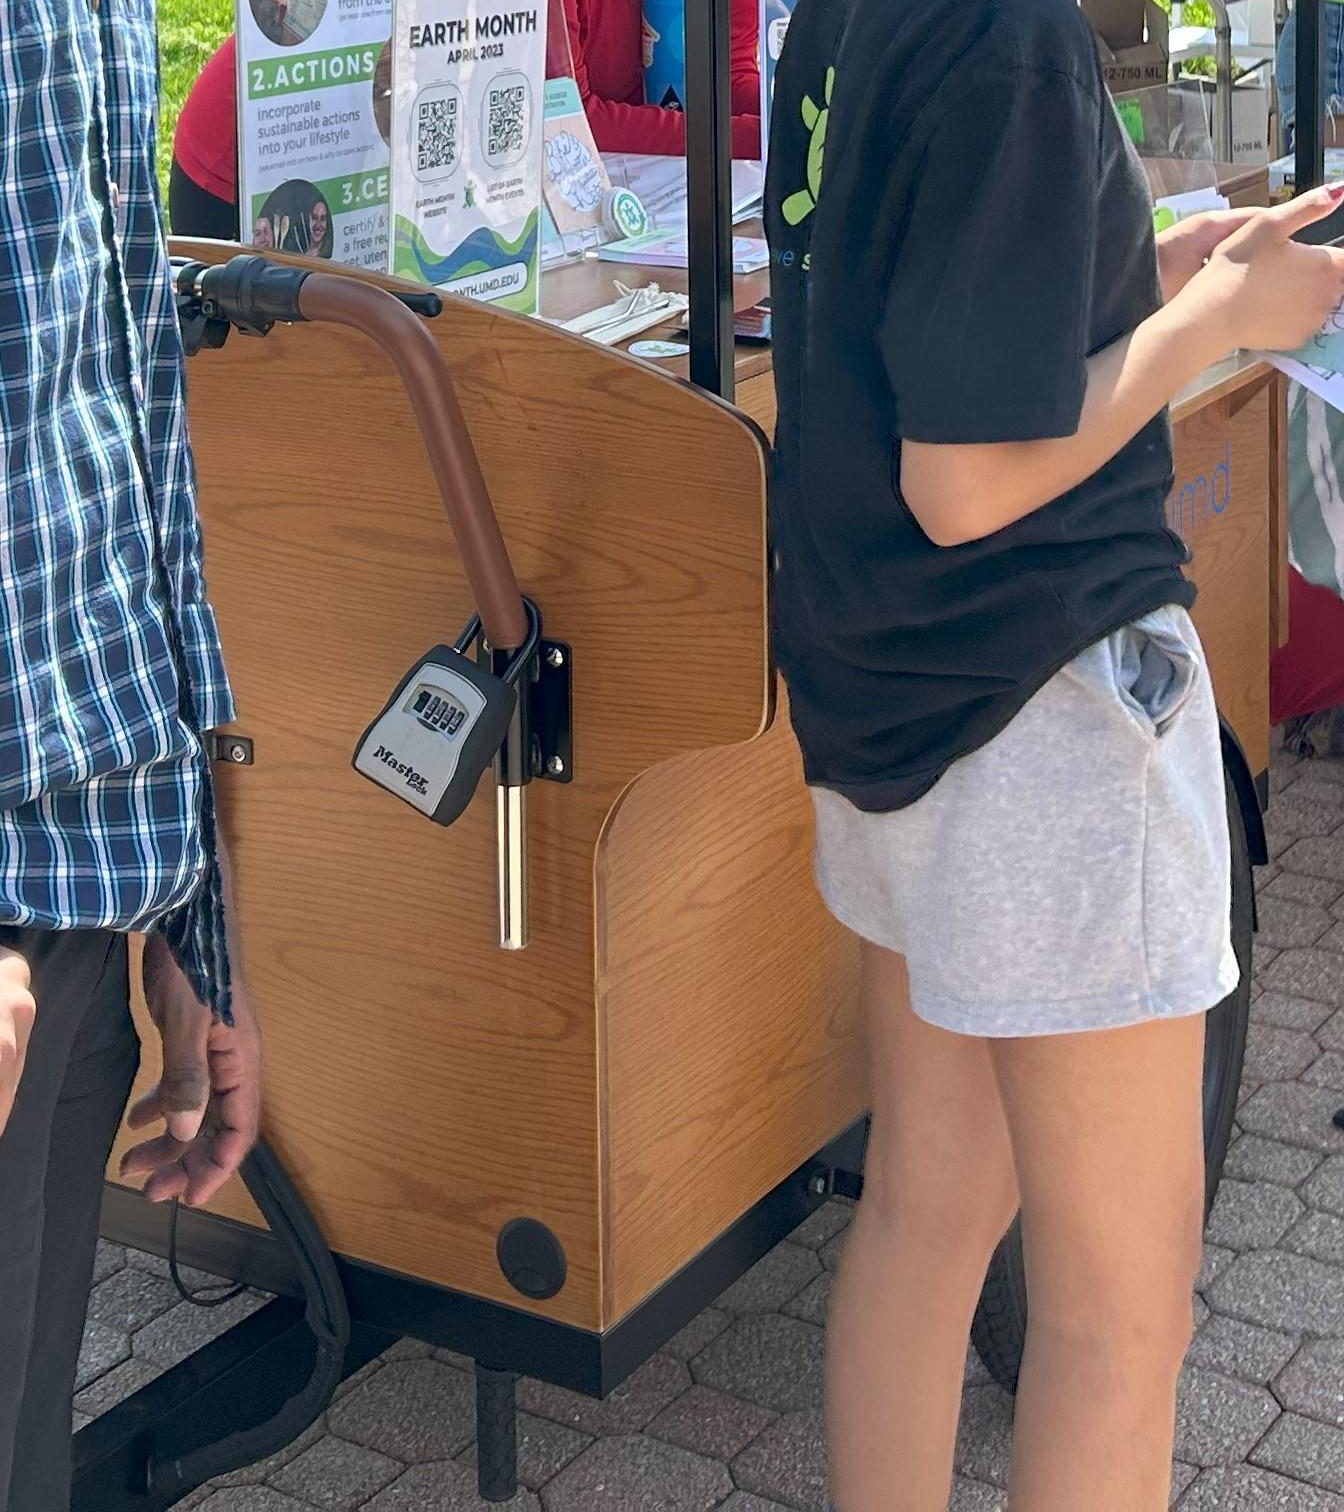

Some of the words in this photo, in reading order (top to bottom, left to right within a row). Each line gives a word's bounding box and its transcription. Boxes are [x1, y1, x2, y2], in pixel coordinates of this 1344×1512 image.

[409, 18, 470, 49] EARTH
[475, 9, 537, 39] MONTH
[447, 48, 478, 64] APRIL
[480, 42, 504, 60] 2023
[252, 51, 374, 91] 2.ACTIONS
[258, 100, 321, 121] incorporate
[258, 116, 320, 138] sustainable
[322, 110, 360, 127] actions
[258, 141, 281, 157] into
[283, 139, 307, 155] your
[309, 127, 350, 146] lifestyle
[343, 215, 377, 236] certify
[377, 214, 385, 228] &
[353, 236, 373, 250] free
[372, 745, 430, 788] Master
[406, 774, 428, 797] Lock
